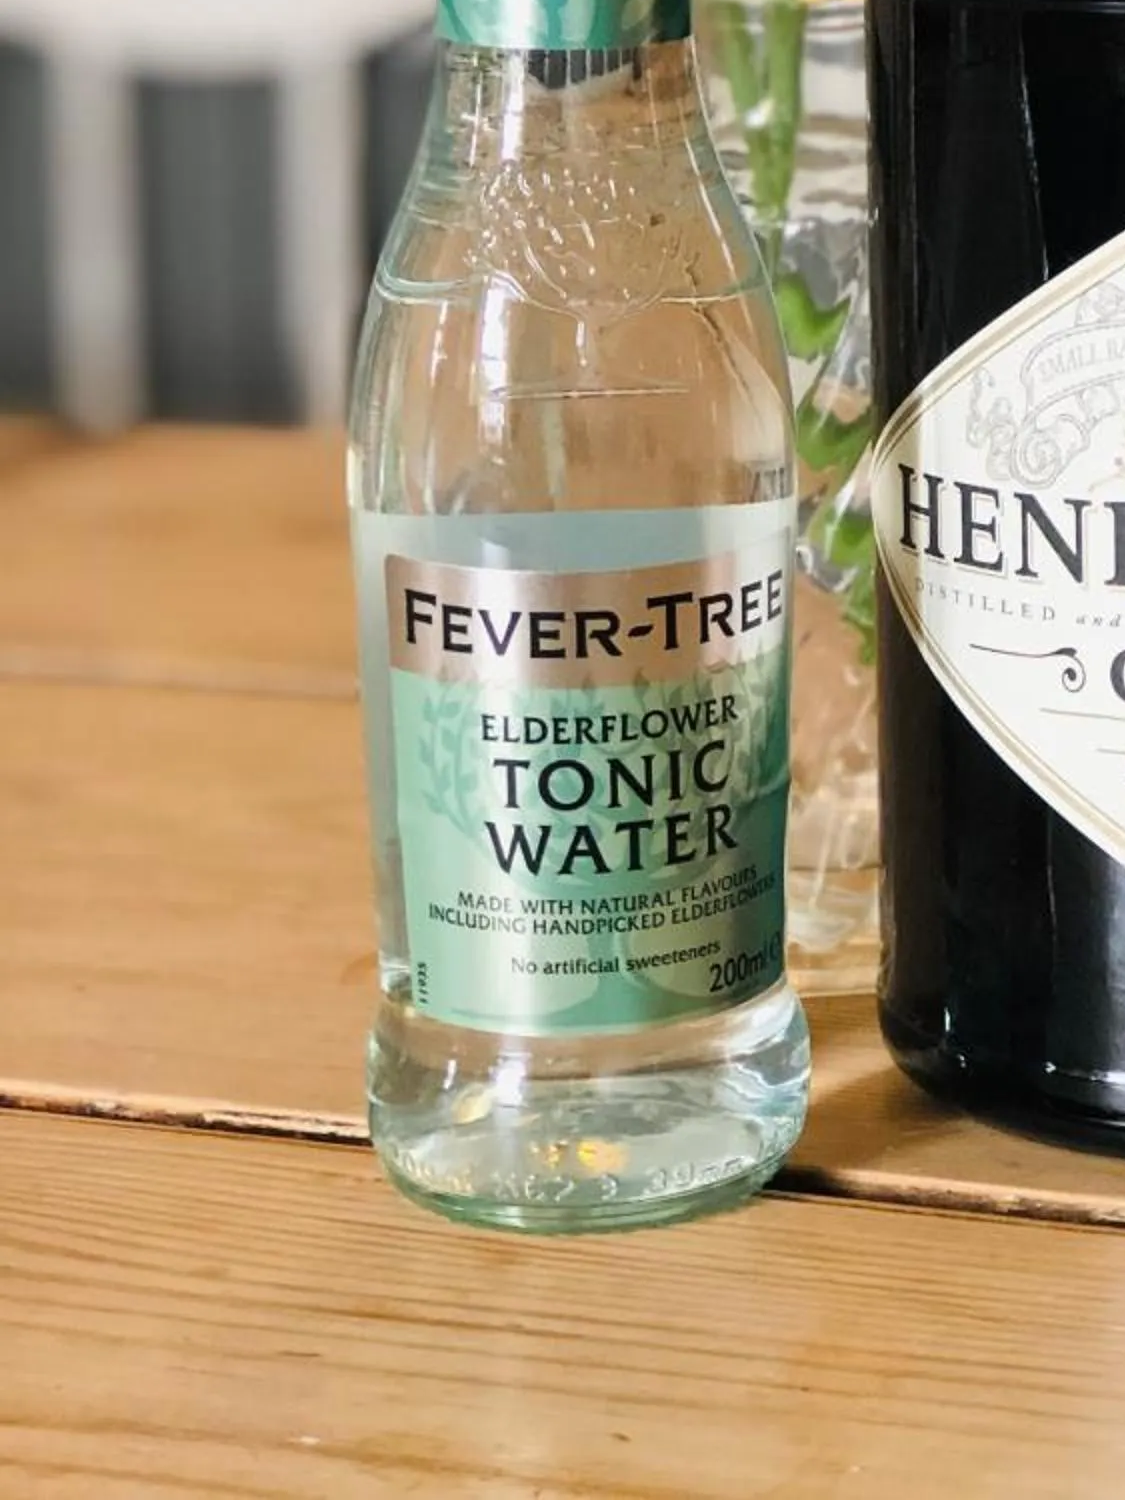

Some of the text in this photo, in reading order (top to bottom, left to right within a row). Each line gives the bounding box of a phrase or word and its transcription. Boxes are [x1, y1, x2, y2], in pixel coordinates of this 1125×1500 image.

[404, 569, 782, 659] FEVER-TREE
[915, 577, 1056, 621] DISTILLED
[1076, 614, 1122, 628] and
[481, 695, 738, 744] ELDERFLOWER
[493, 740, 730, 812] TONIC
[485, 804, 739, 877] WATER
[457, 864, 757, 915] MADE WITH NATURAL FLAVOURS
[429, 903, 527, 934] INCLUDING
[532, 911, 665, 936] HANDPICKED
[511, 940, 721, 975] No artificial sweeteners
